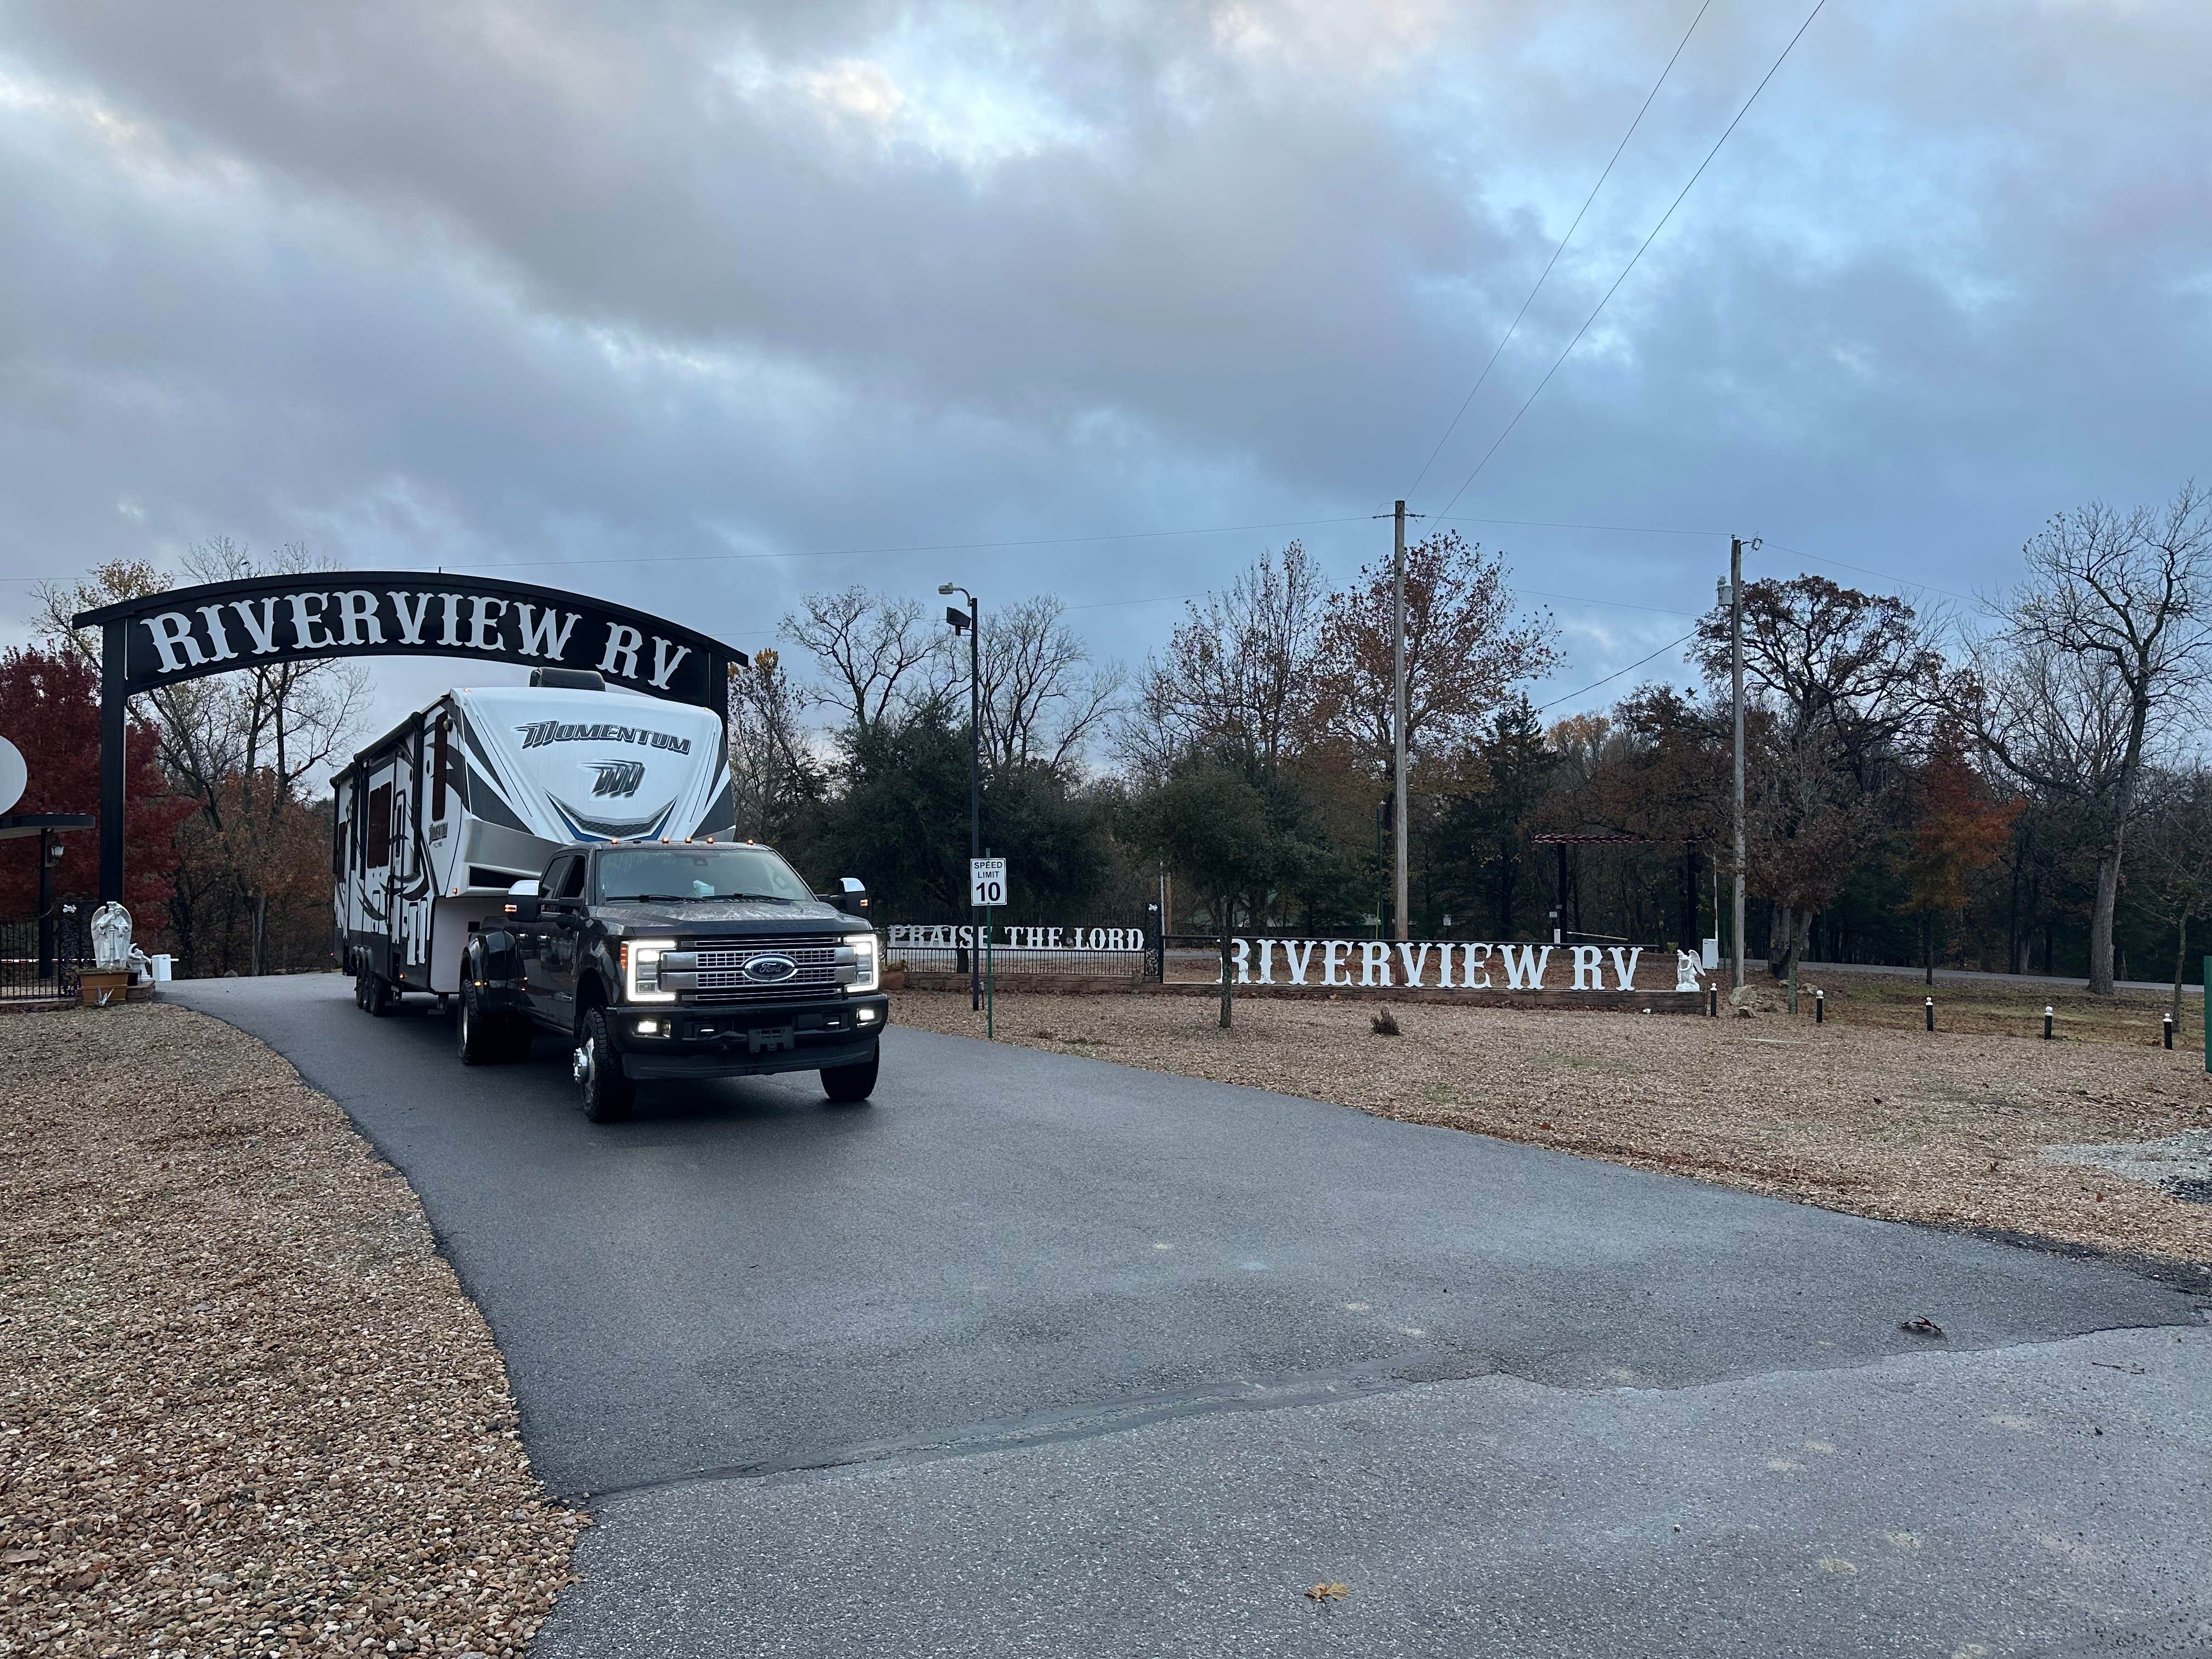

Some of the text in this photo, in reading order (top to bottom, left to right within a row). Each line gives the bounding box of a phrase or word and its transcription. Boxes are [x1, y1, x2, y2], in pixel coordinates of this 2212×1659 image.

[140, 589, 692, 690] RIVERVIEW RV
[514, 720, 691, 755] MOMENTUM
[976, 882, 1001, 902] 10
[889, 924, 1145, 951] PRAISE THE LORD
[759, 963, 783, 973] Ford
[1214, 938, 1644, 991] RIVERVIEW RV
